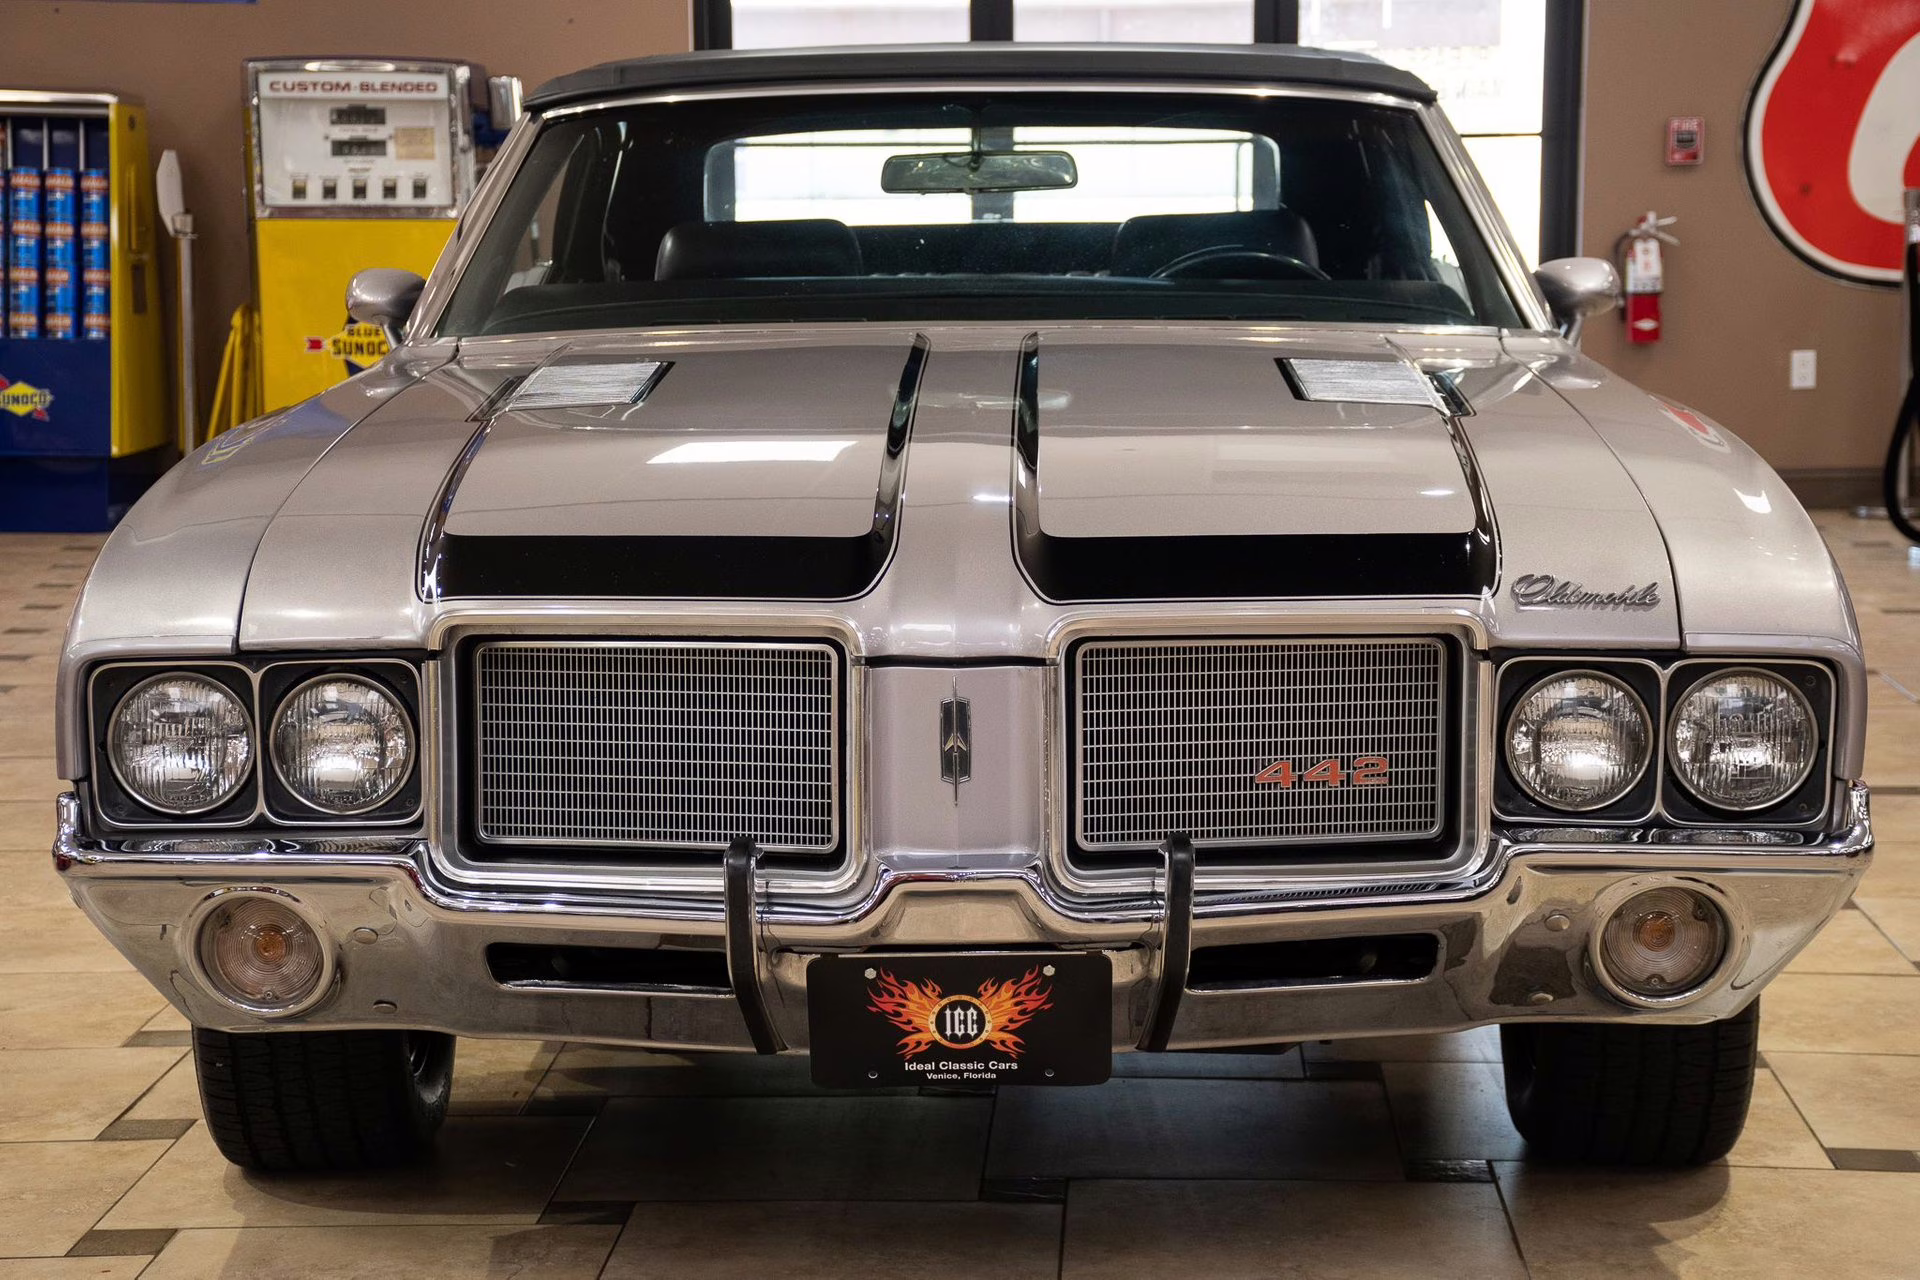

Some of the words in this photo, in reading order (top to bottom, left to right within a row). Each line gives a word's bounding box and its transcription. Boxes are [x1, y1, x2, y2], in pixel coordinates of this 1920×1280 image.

[347, 326, 381, 336] BLUE
[332, 339, 389, 356] SUNOC
[0, 393, 48, 406] UNOCO
[1255, 756, 1389, 788] 442
[904, 1061, 935, 1071] Ideal
[939, 1061, 985, 1070] Classic
[988, 1060, 1018, 1070] Cars
[926, 1072, 961, 1080] Venice,
